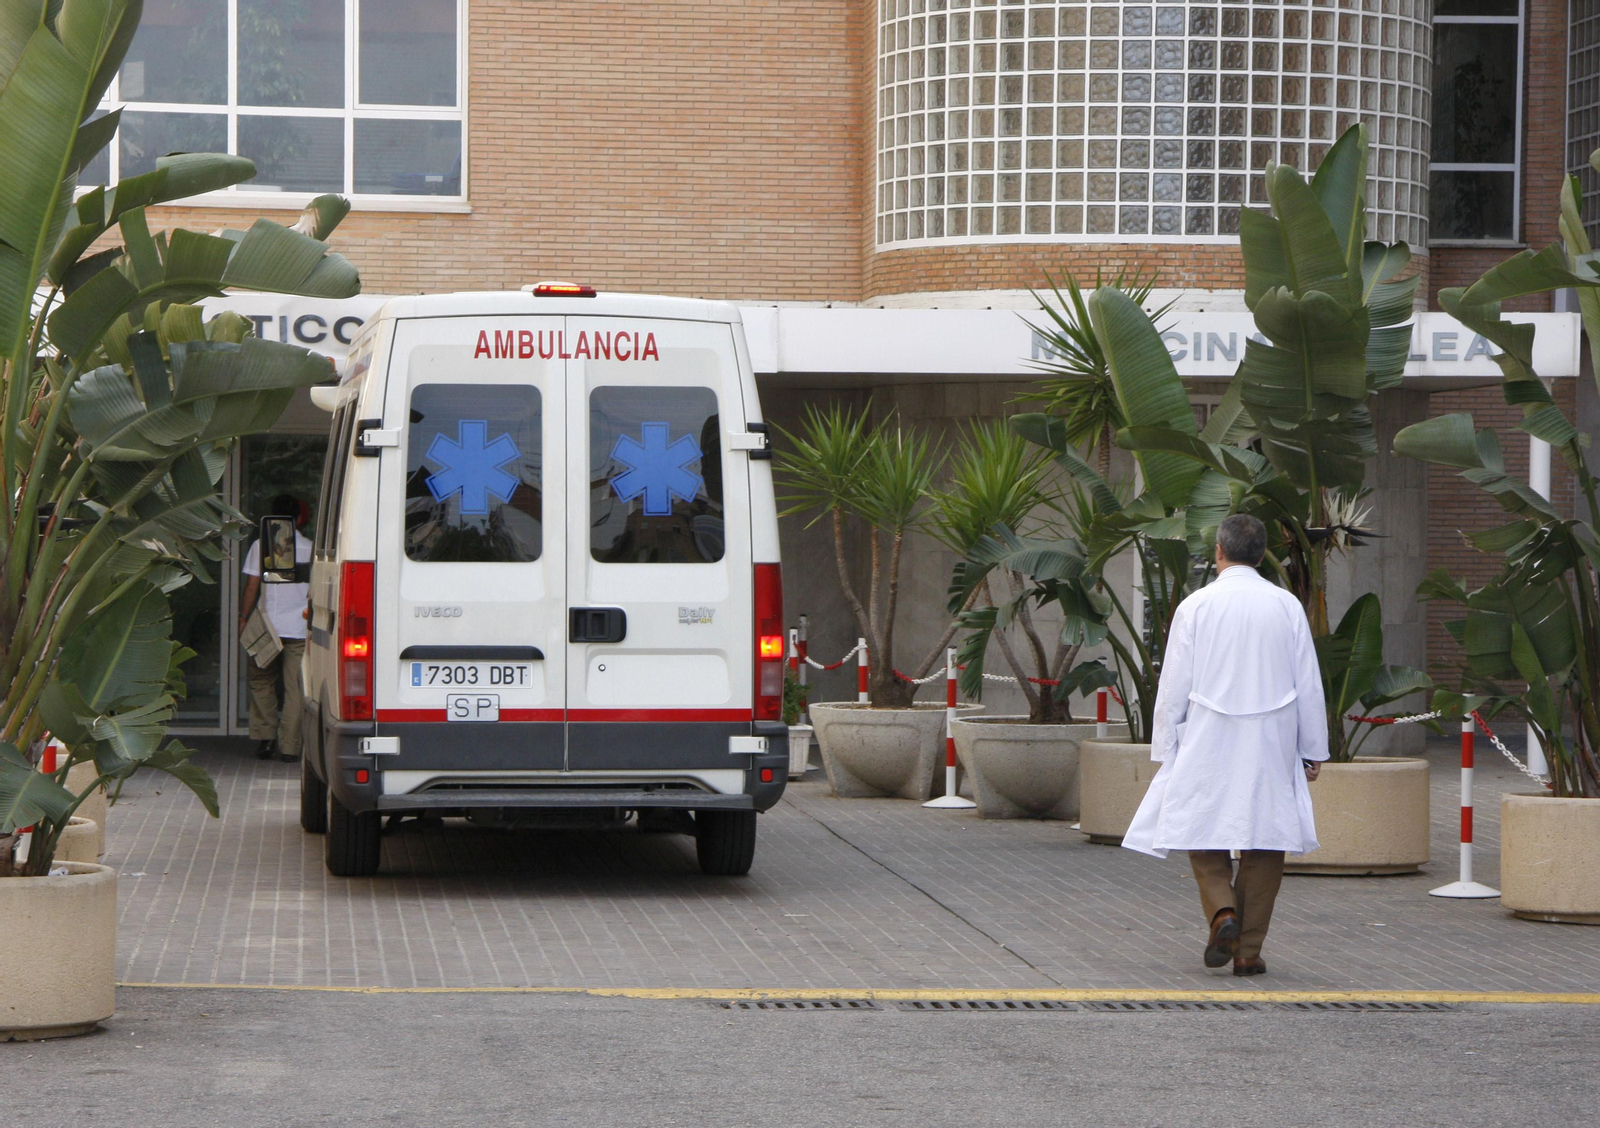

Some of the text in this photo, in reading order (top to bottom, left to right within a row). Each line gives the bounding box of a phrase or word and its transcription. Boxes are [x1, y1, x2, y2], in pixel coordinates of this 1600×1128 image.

[211, 313, 366, 345] TICO
[474, 329, 660, 362] AMBULANCIA
[414, 606, 463, 618] IVECO
[678, 606, 716, 618] Daily
[428, 665, 528, 685] 7303 DBT
